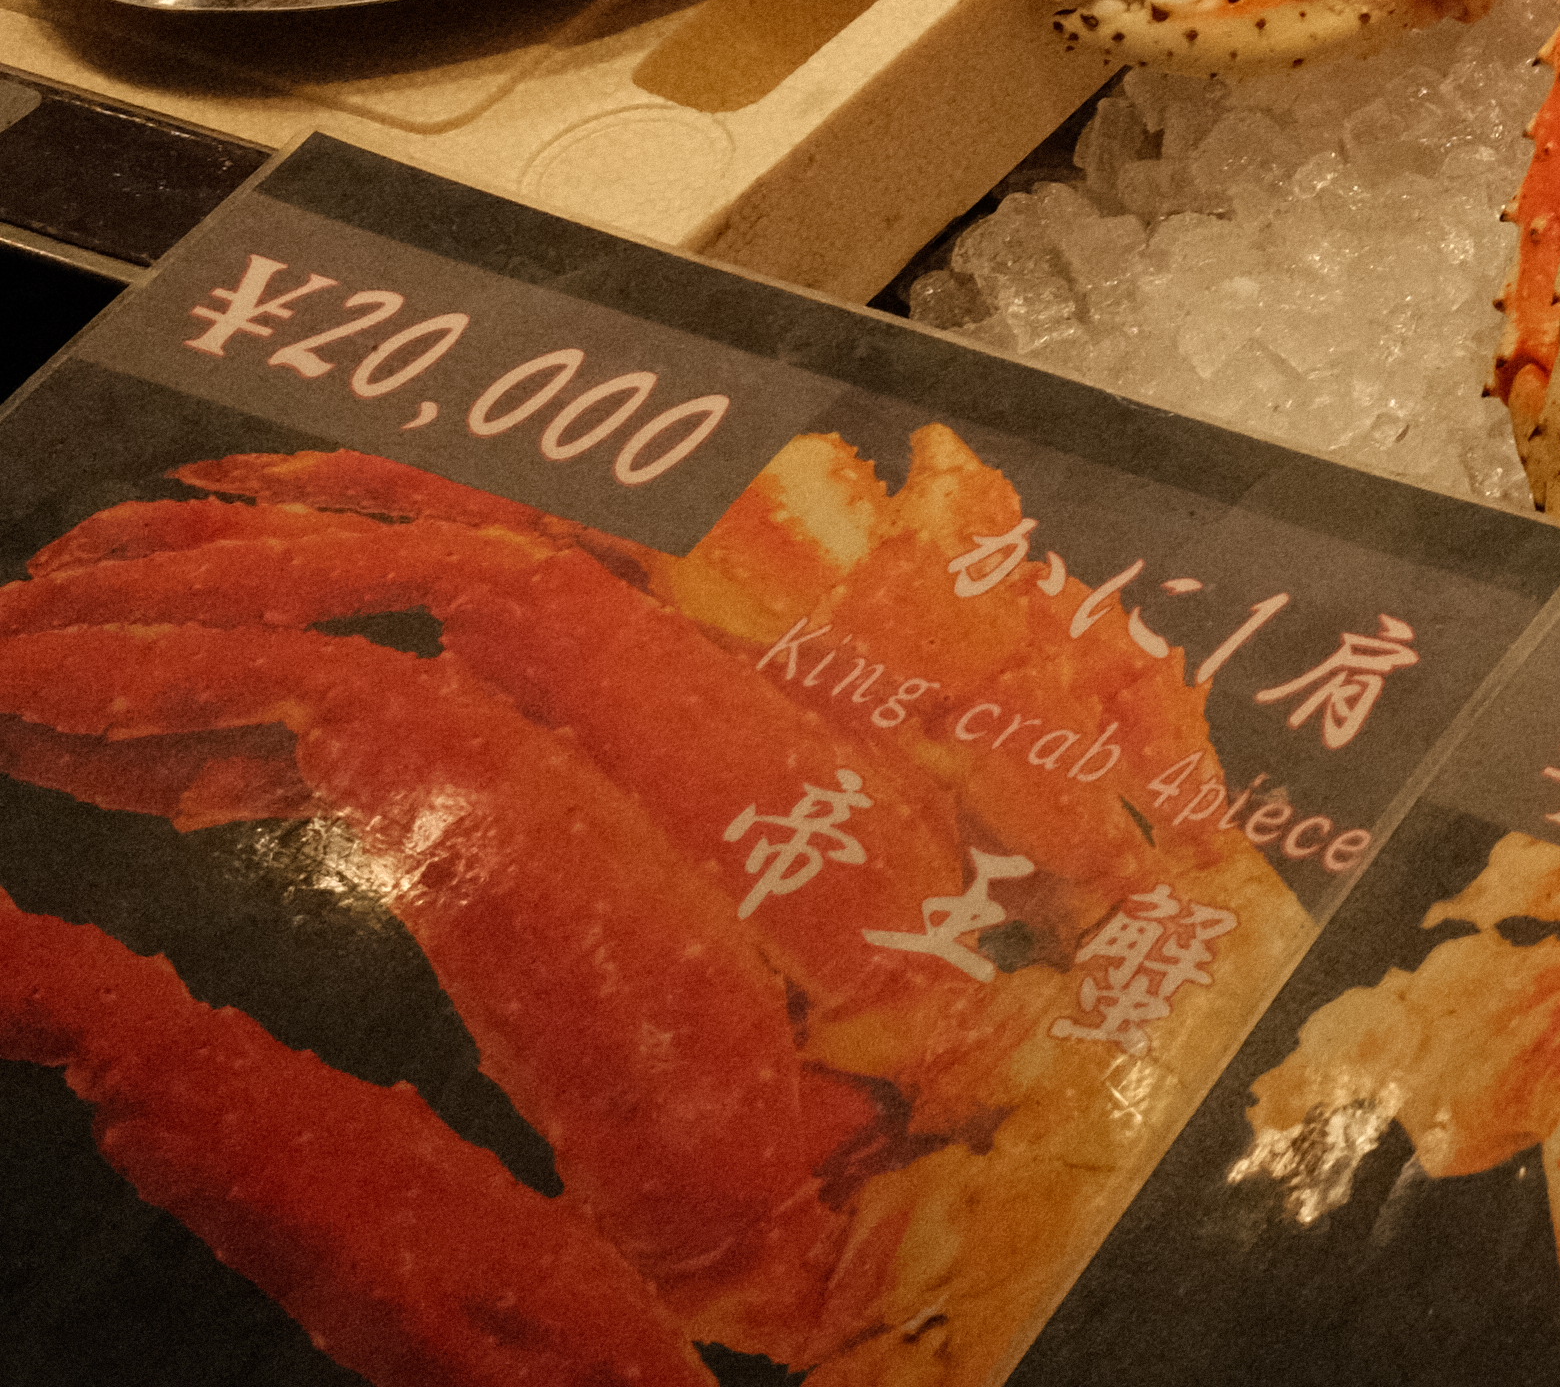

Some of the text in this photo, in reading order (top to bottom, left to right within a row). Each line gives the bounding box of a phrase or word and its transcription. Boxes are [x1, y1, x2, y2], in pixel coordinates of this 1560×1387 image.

[183, 254, 731, 487] ¥20,000
[756, 617, 941, 729] King
[953, 701, 1122, 783] crab
[947, 517, 1420, 750] かに1肩
[722, 768, 1239, 1057] 帝王蟹
